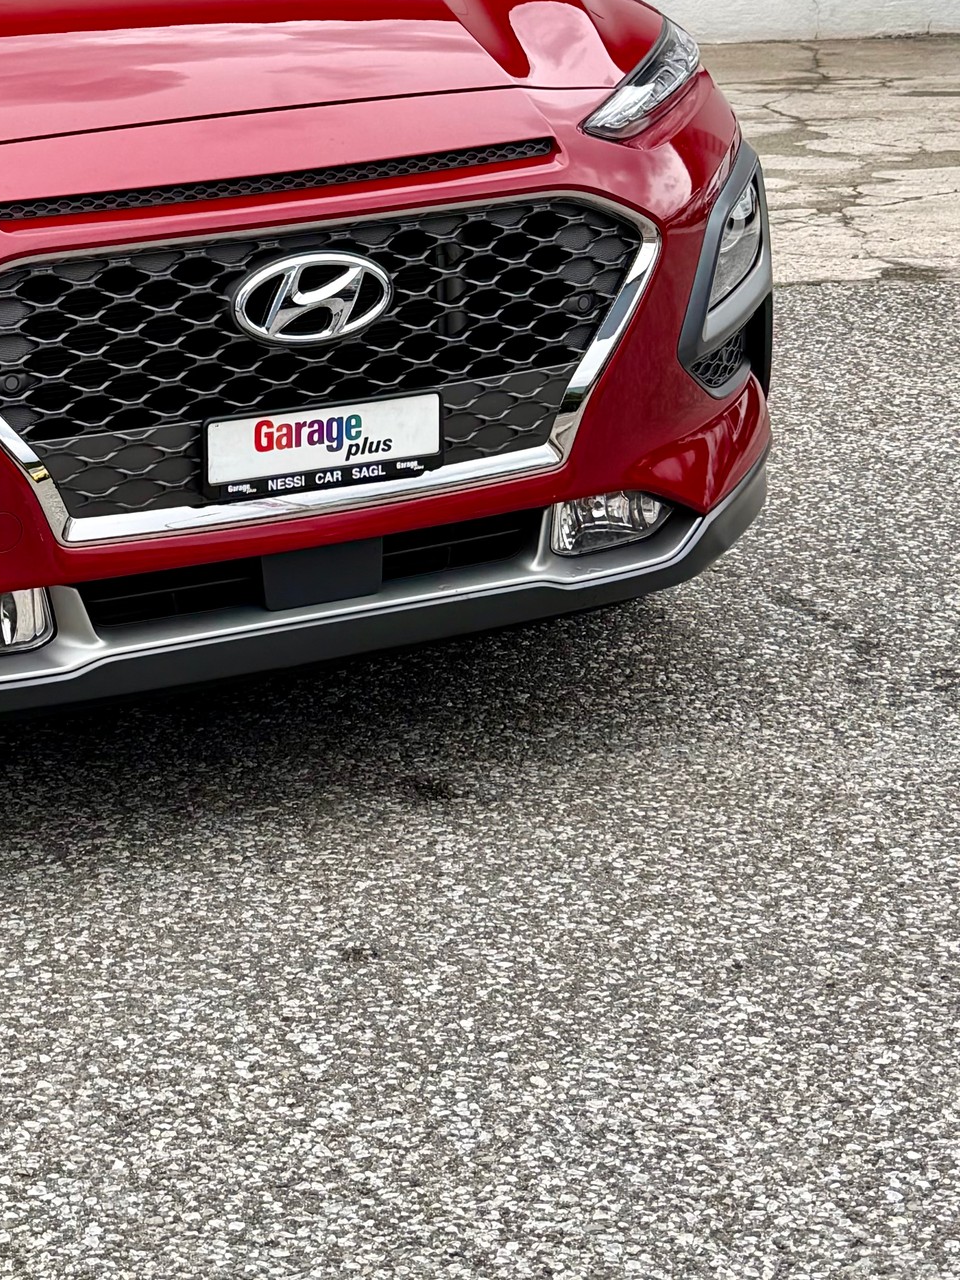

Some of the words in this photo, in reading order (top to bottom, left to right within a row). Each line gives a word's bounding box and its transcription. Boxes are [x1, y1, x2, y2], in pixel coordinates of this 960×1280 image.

[254, 414, 362, 453] Garage
[345, 437, 393, 461] plus
[268, 476, 305, 491] NESSI
[315, 470, 342, 484] CAR
[352, 465, 386, 479] SAGL
